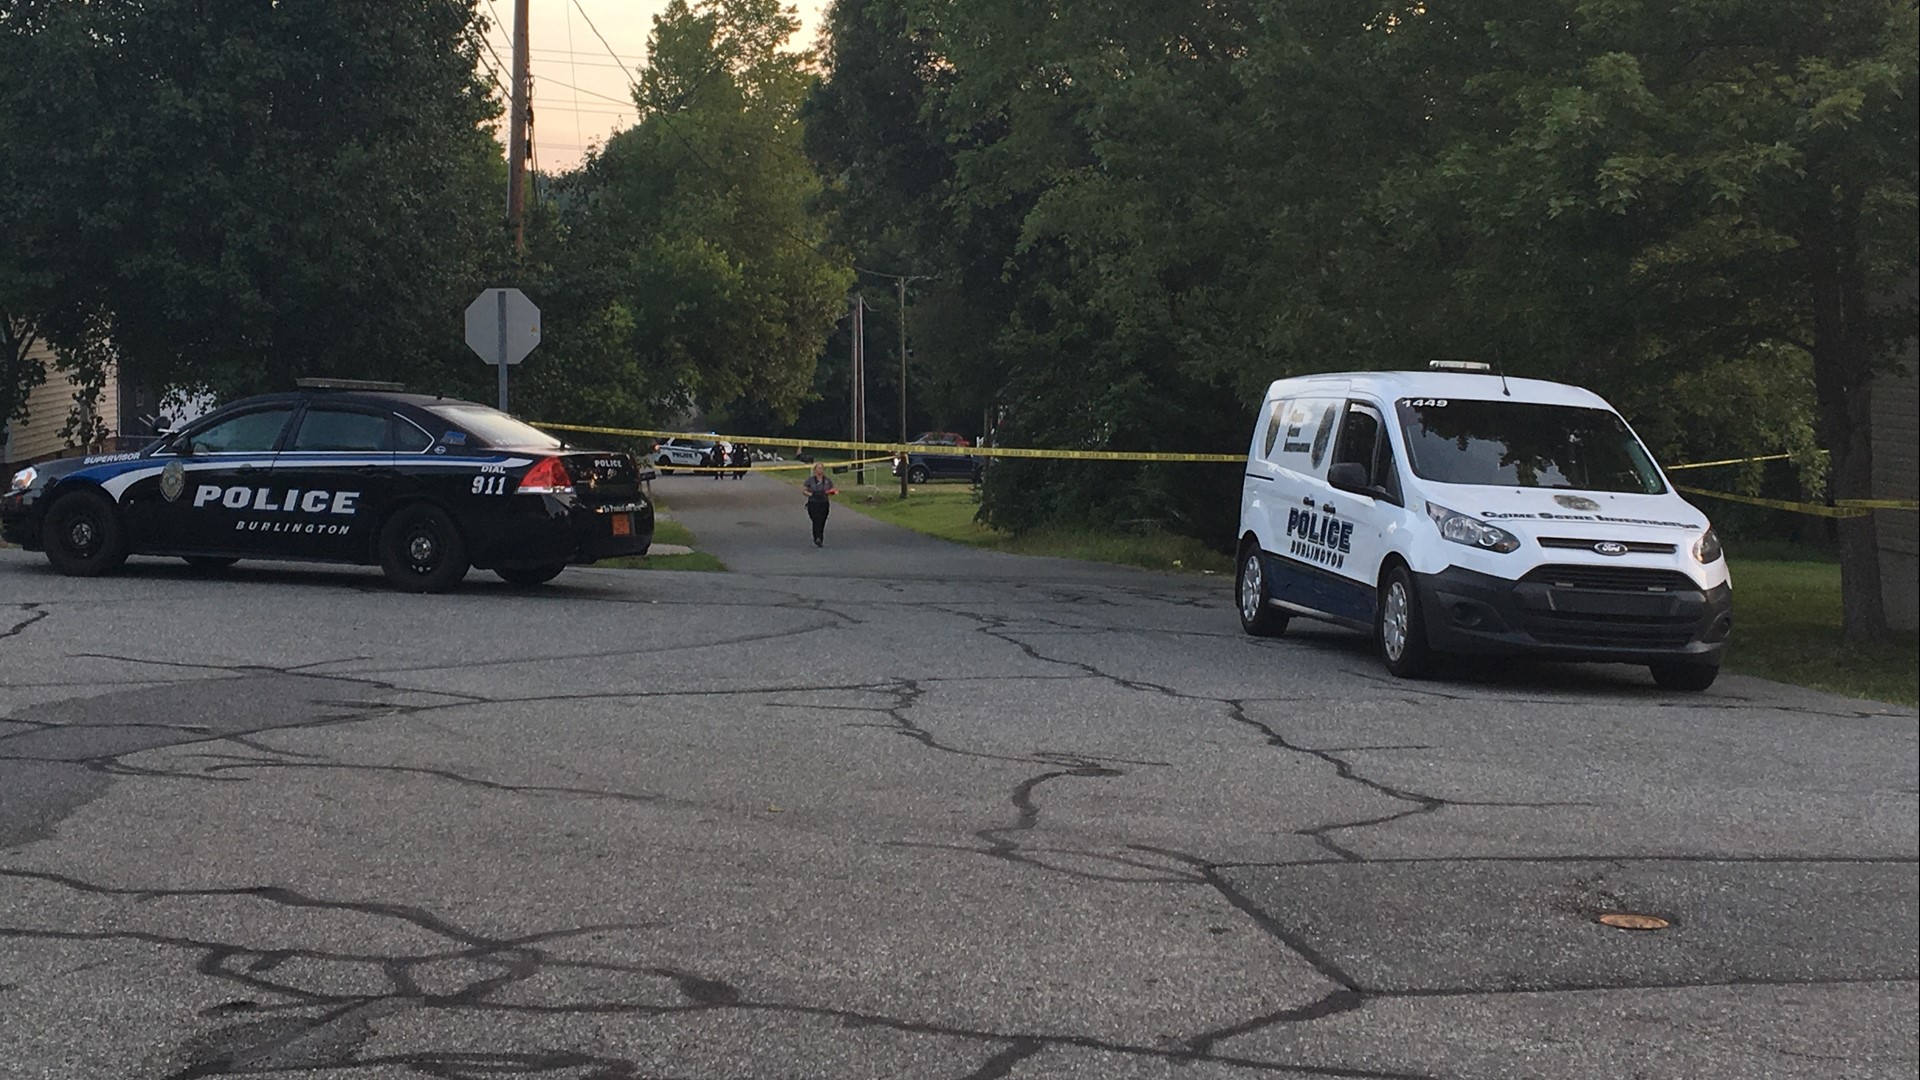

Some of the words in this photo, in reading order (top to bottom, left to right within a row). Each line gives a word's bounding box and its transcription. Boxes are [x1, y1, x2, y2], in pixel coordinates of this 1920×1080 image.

[84, 452, 140, 465] SUPERVISOR
[481, 465, 506, 474] DIAL
[472, 476, 506, 495] 911
[193, 485, 360, 514] POLICE
[235, 520, 350, 535] BURLINGTON
[1286, 507, 1354, 554] POLICE
[1290, 540, 1344, 569] BURLINGTON
